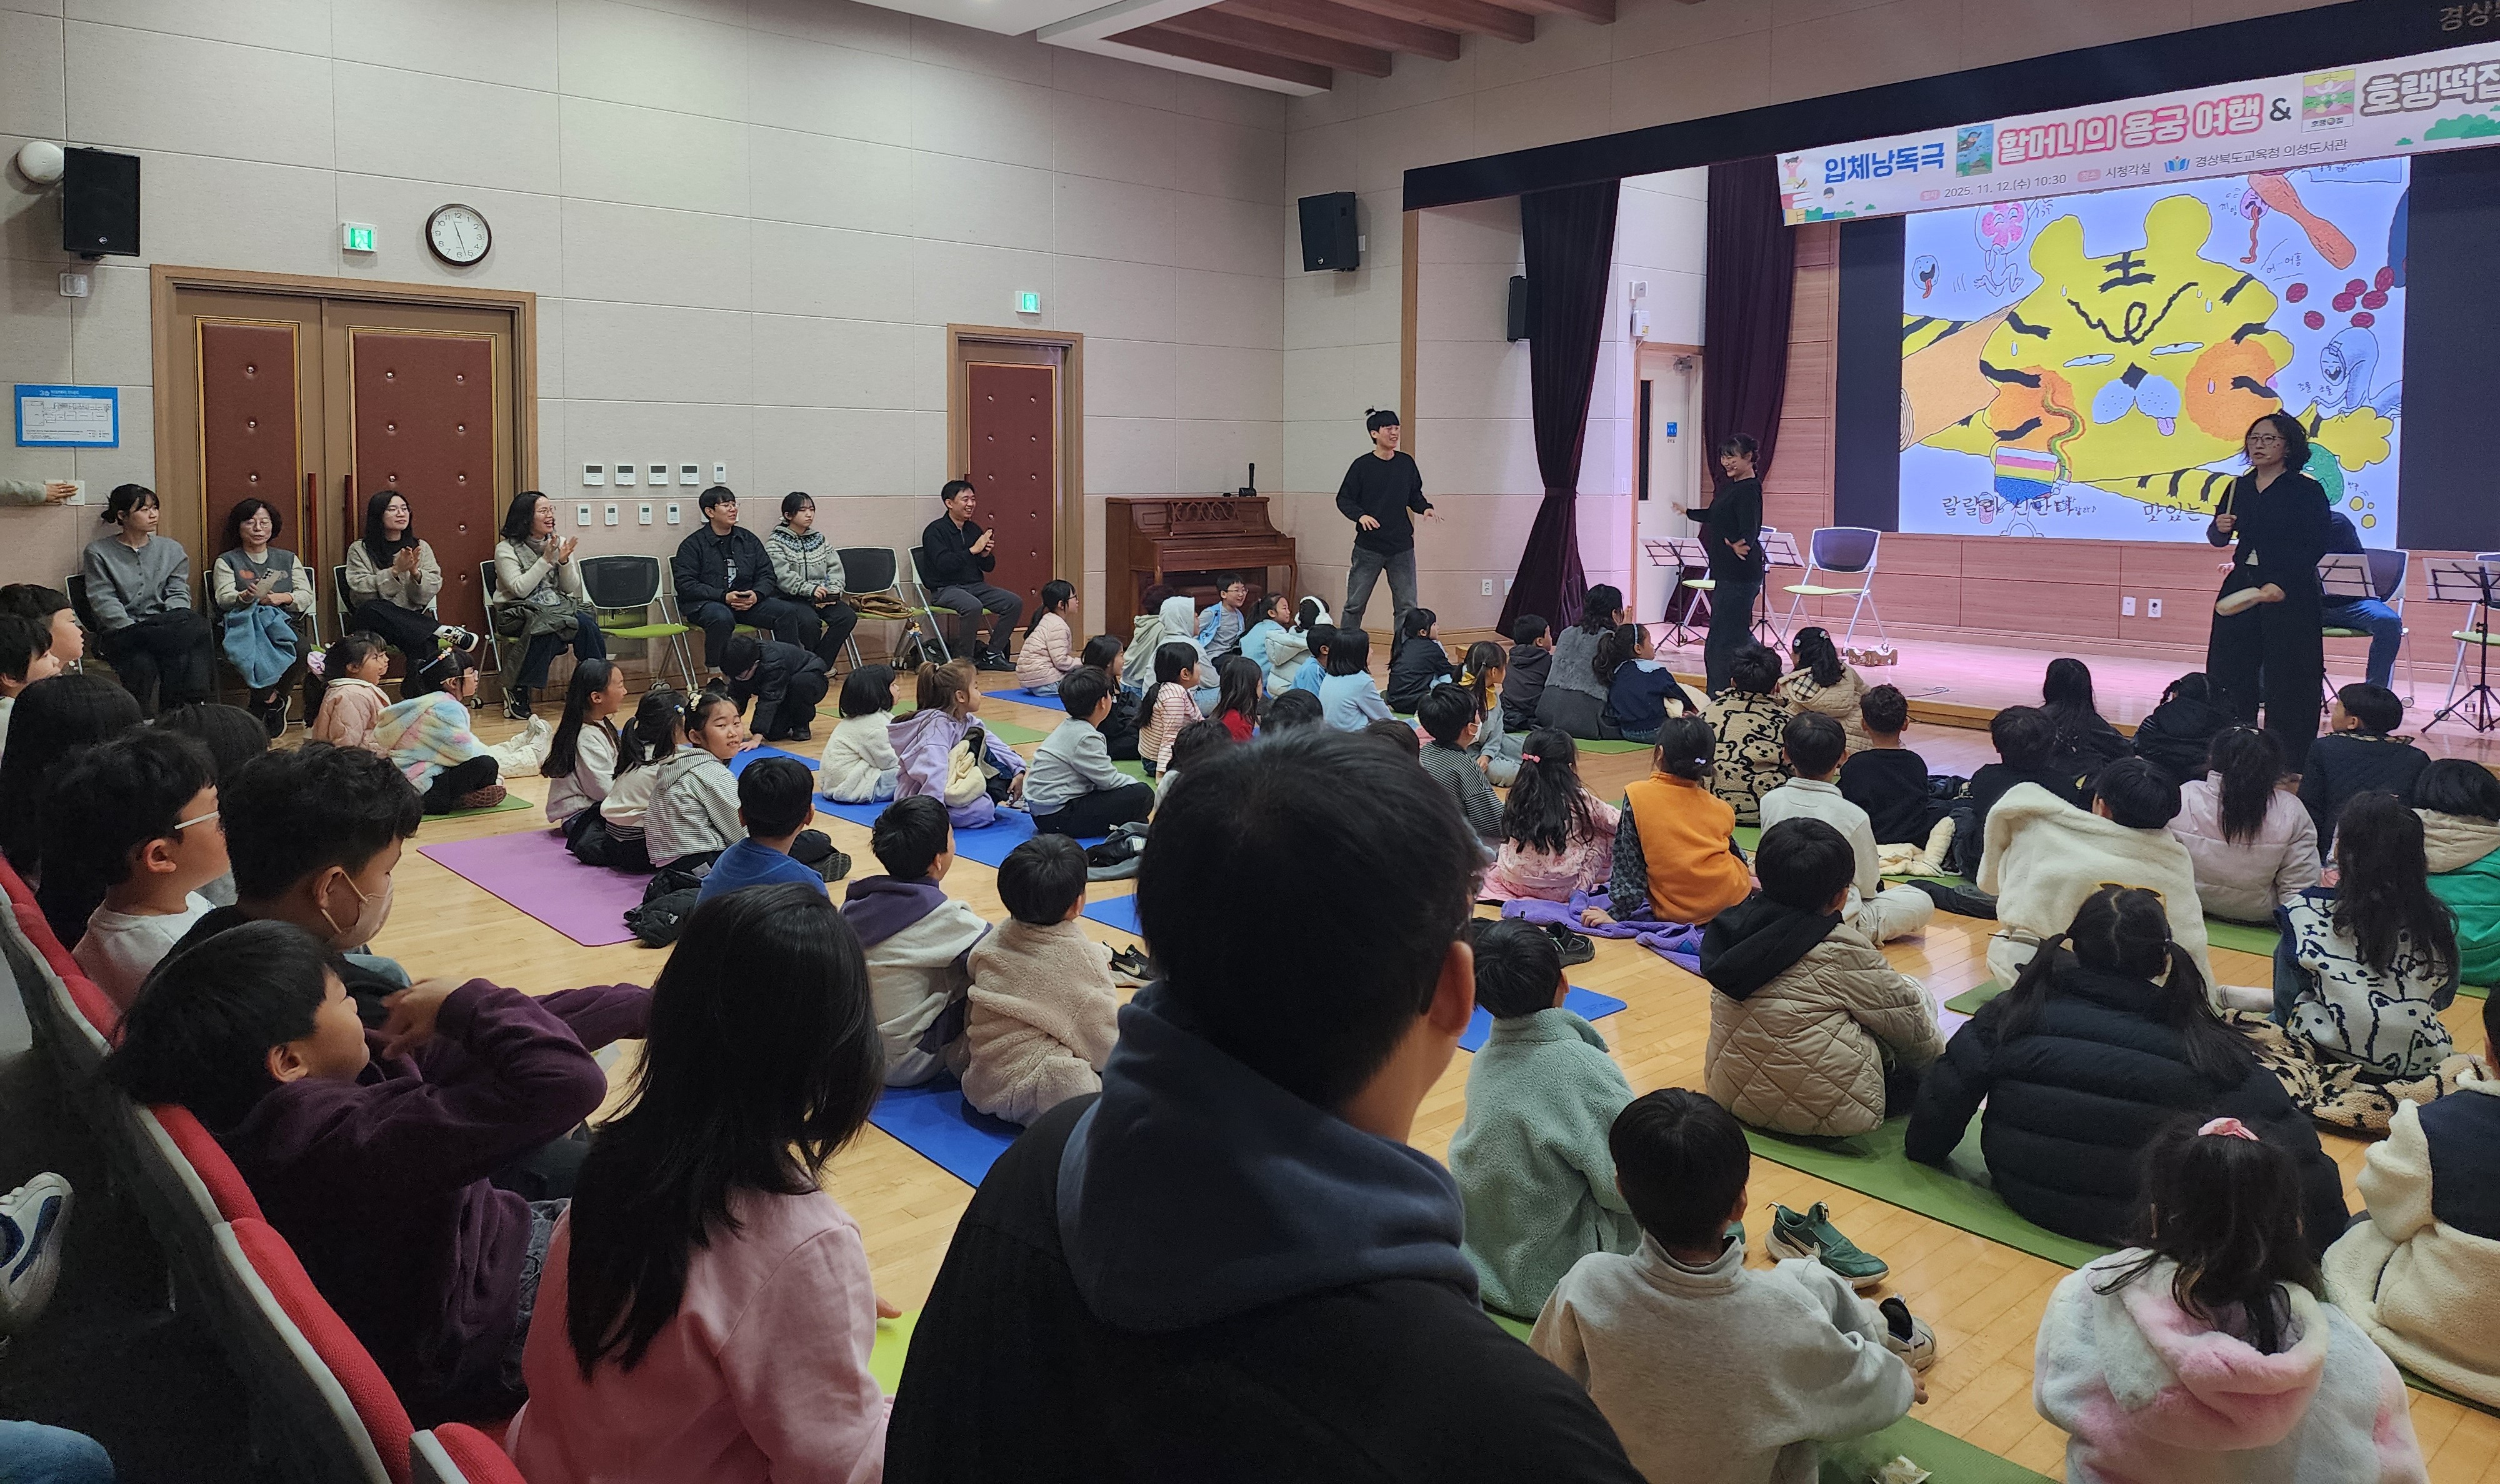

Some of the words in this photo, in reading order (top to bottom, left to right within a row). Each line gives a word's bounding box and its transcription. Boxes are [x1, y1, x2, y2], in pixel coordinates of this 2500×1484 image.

[2440, 0, 2500, 31] 경상
[1824, 142, 1945, 184] 입체낭독극
[1998, 116, 2117, 165] 할머니의
[2122, 104, 2189, 148] 용궁
[2193, 93, 2264, 138] 여행
[2269, 97, 2292, 122] &
[1944, 186, 1973, 198] 2025.
[1977, 184, 1992, 193] 11.
[1996, 178, 2031, 191] 12.(수)
[2034, 174, 2066, 187] 10:30
[2105, 162, 2151, 179] 시청각실
[2195, 147, 2280, 167] 경상북도교육청
[2282, 139, 2348, 157] 의성도서관
[2142, 501, 2201, 523] 맛있는
